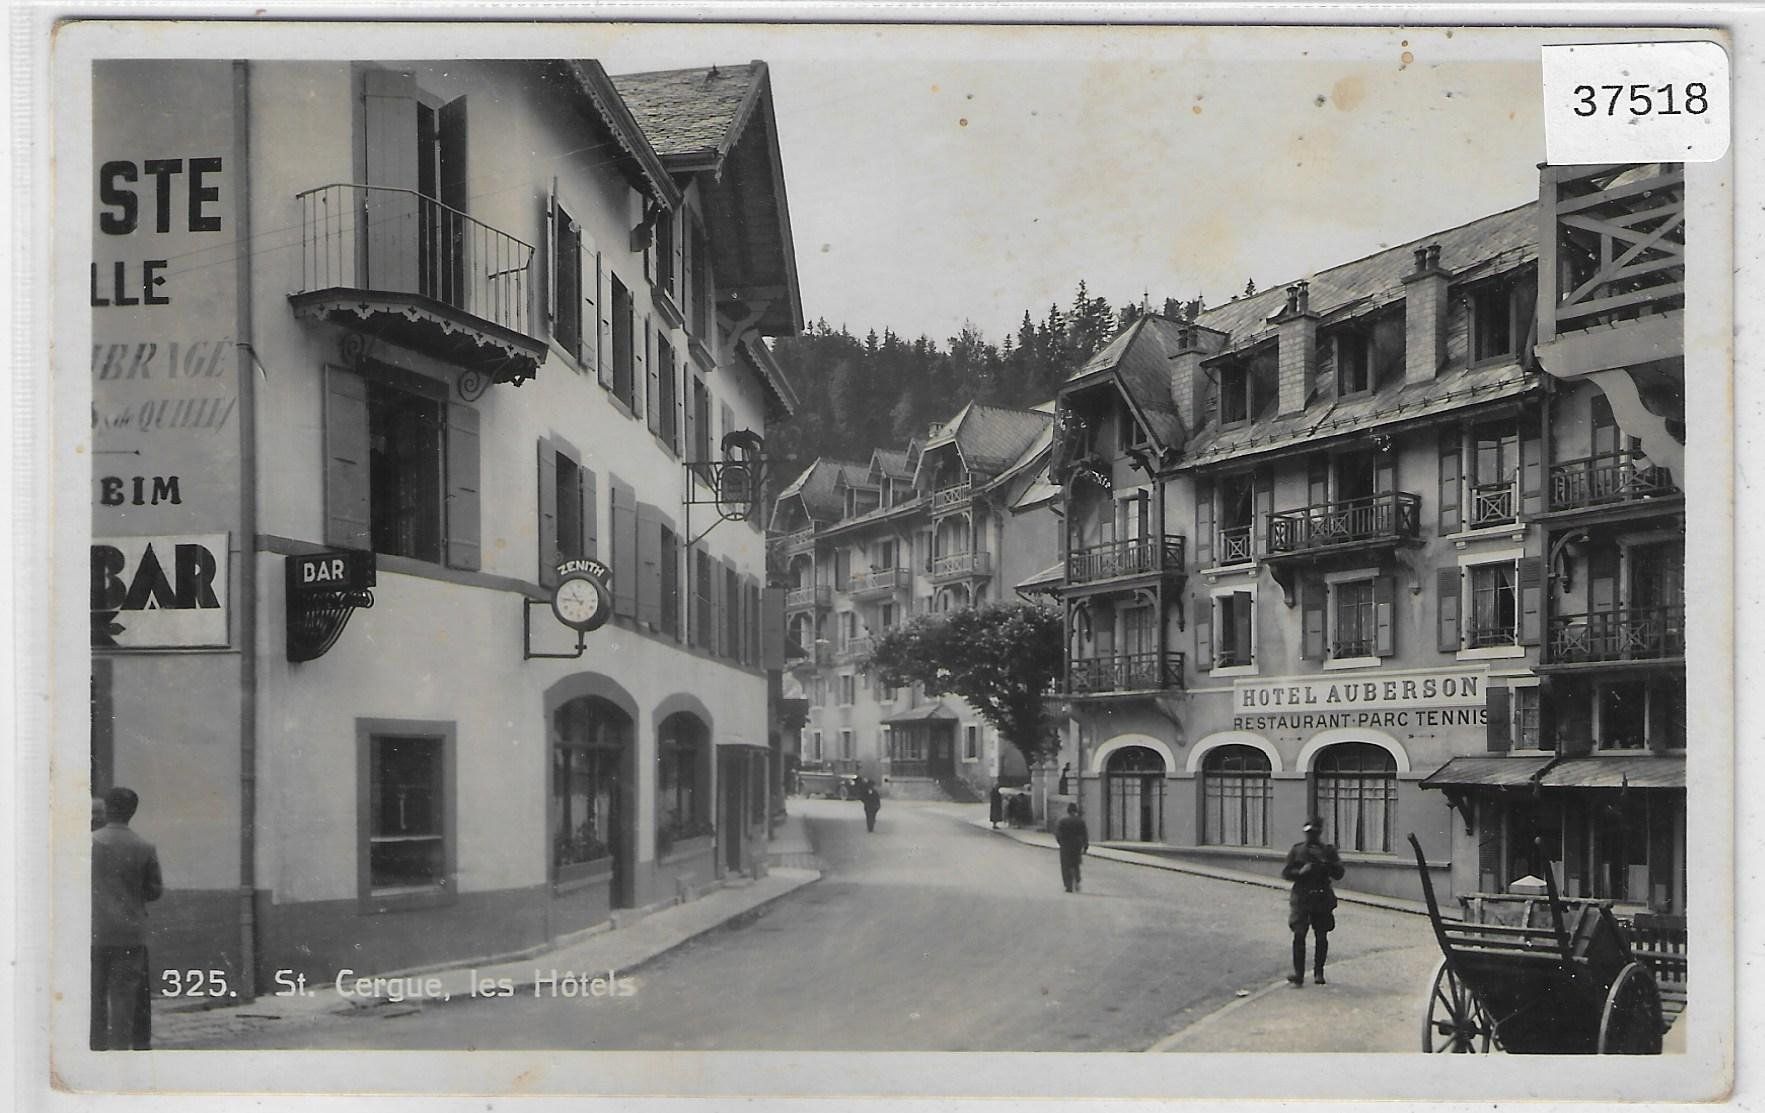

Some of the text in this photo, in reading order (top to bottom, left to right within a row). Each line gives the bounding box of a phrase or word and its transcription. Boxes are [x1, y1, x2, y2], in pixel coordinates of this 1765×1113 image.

[1573, 82, 1708, 117] 37518
[99, 157, 223, 235] STE
[90, 260, 170, 307] LLE
[99, 476, 182, 506] BIM
[90, 542, 221, 611] BAR
[303, 559, 345, 583] BAR
[556, 560, 605, 577] ZENITH
[1242, 676, 1478, 707] HOTEL AUBERSON
[1415, 708, 1488, 727] TENNIS
